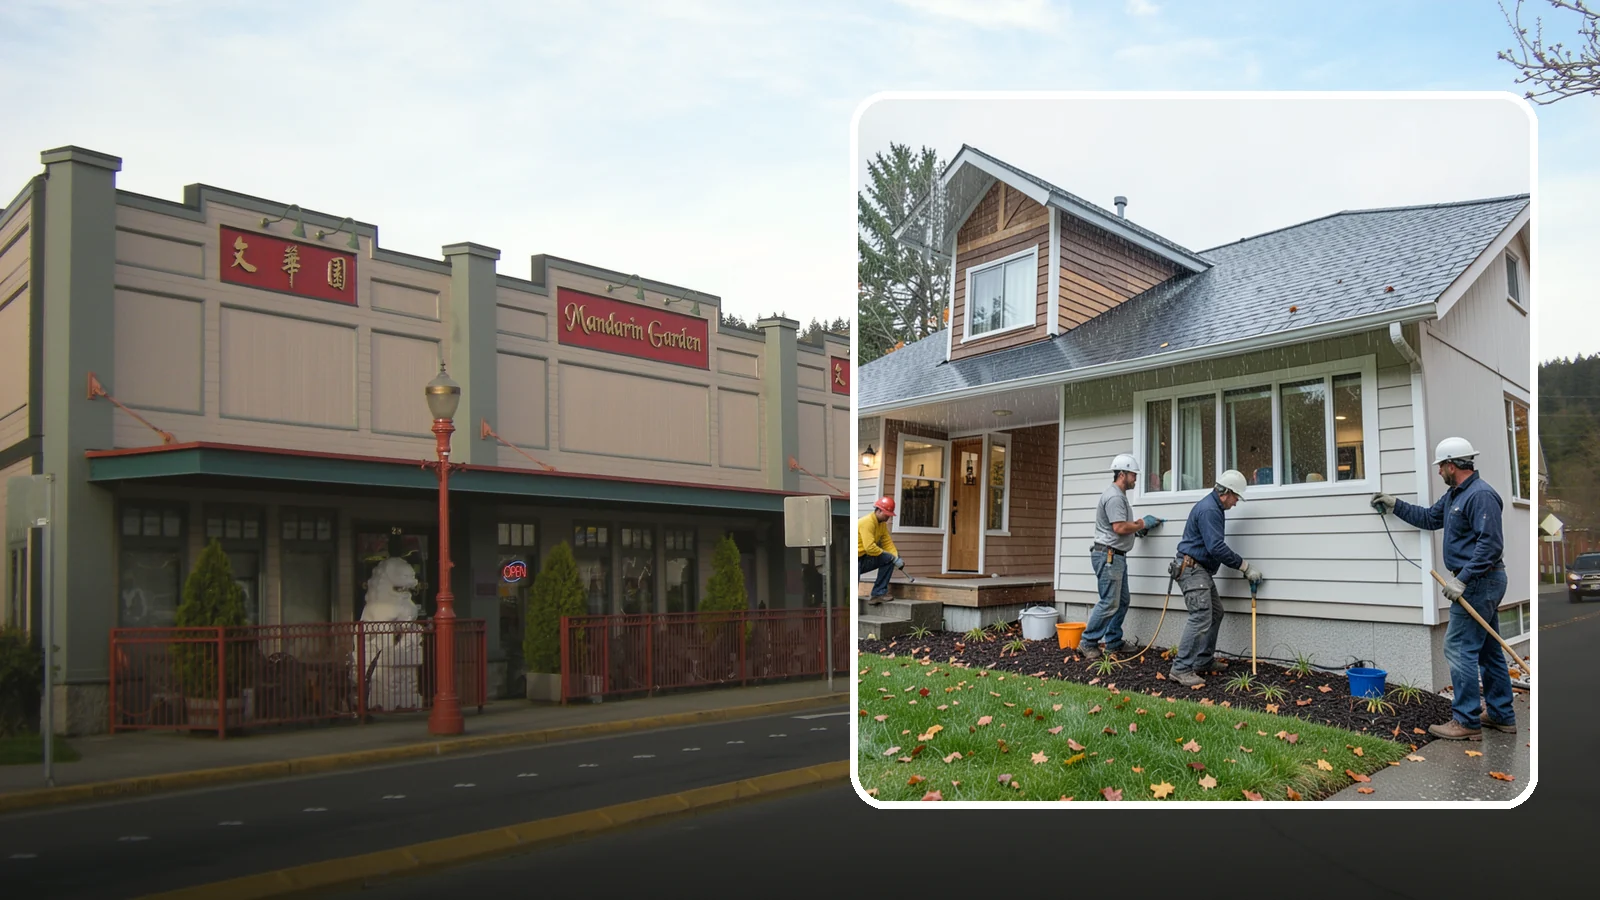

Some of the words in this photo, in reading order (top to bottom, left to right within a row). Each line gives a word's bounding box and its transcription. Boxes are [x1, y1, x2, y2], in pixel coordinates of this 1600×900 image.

[564, 302, 644, 342] Mandarin
[648, 320, 701, 352] Garden
[503, 565, 527, 578] OPEN
